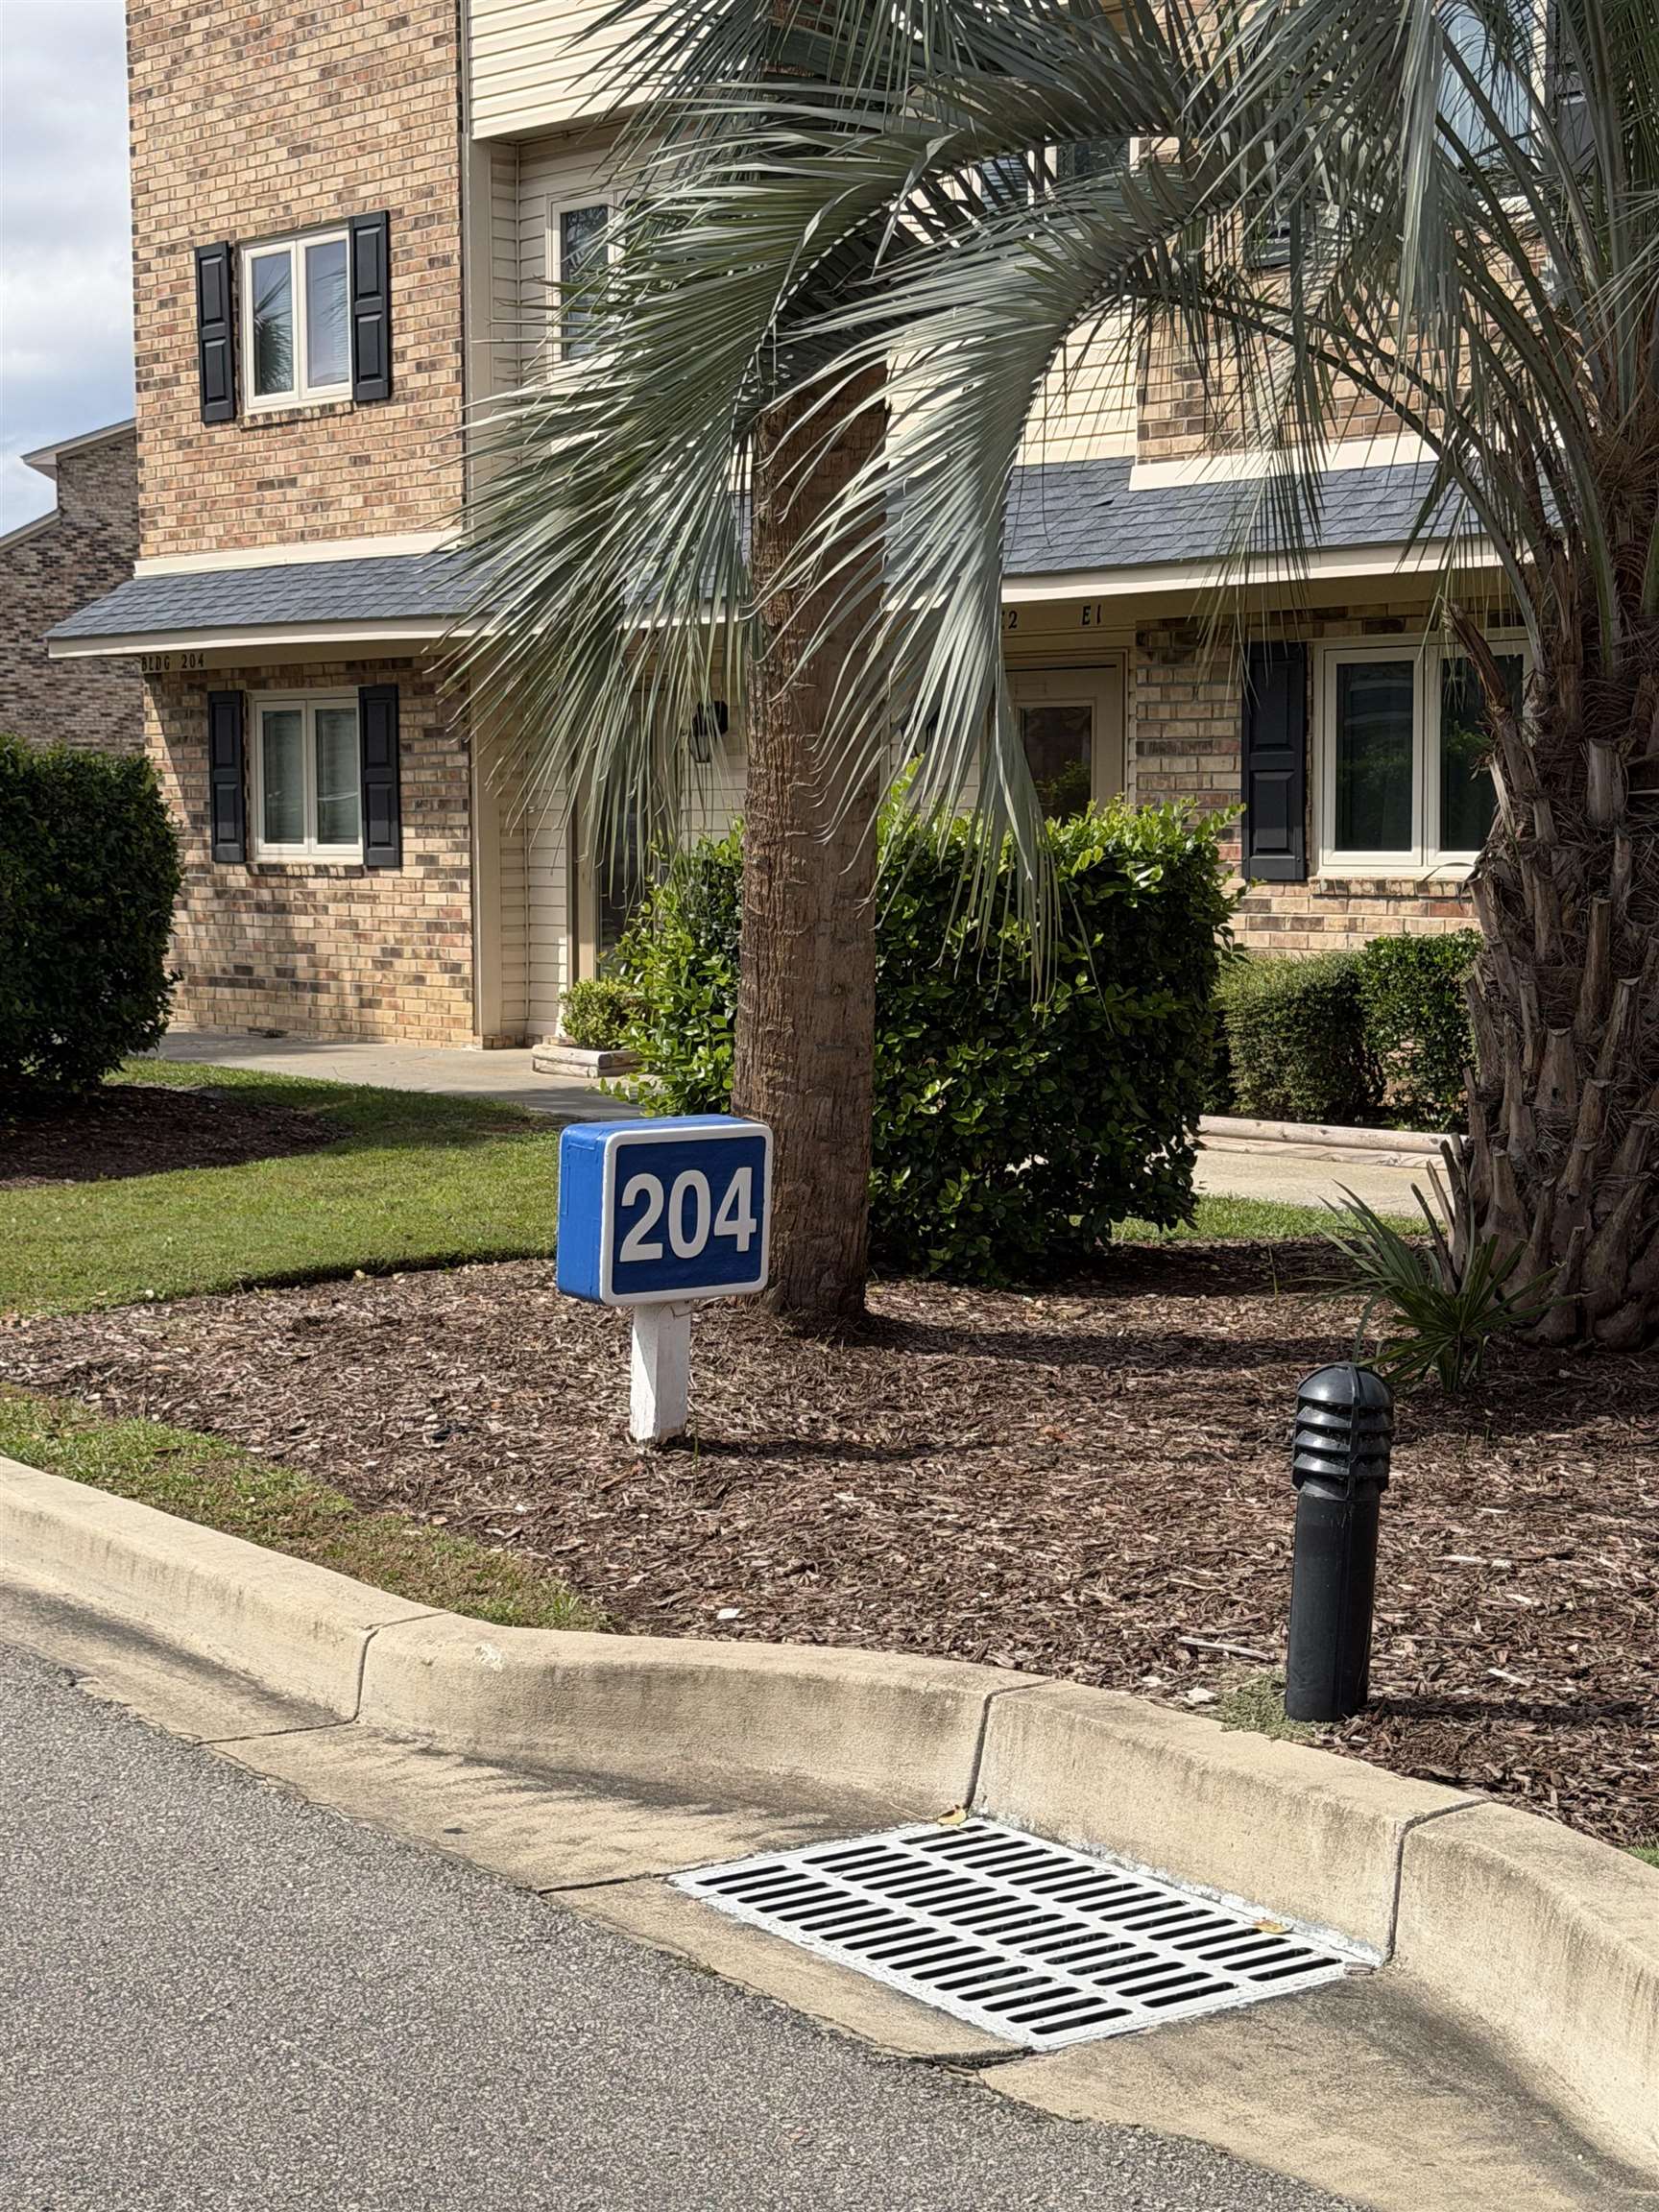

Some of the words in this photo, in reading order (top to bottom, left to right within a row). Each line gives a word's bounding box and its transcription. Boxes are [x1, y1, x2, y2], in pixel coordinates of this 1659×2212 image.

[141, 655, 170, 671] BLDG
[180, 653, 204, 669] 204
[619, 1166, 757, 1262] 204
